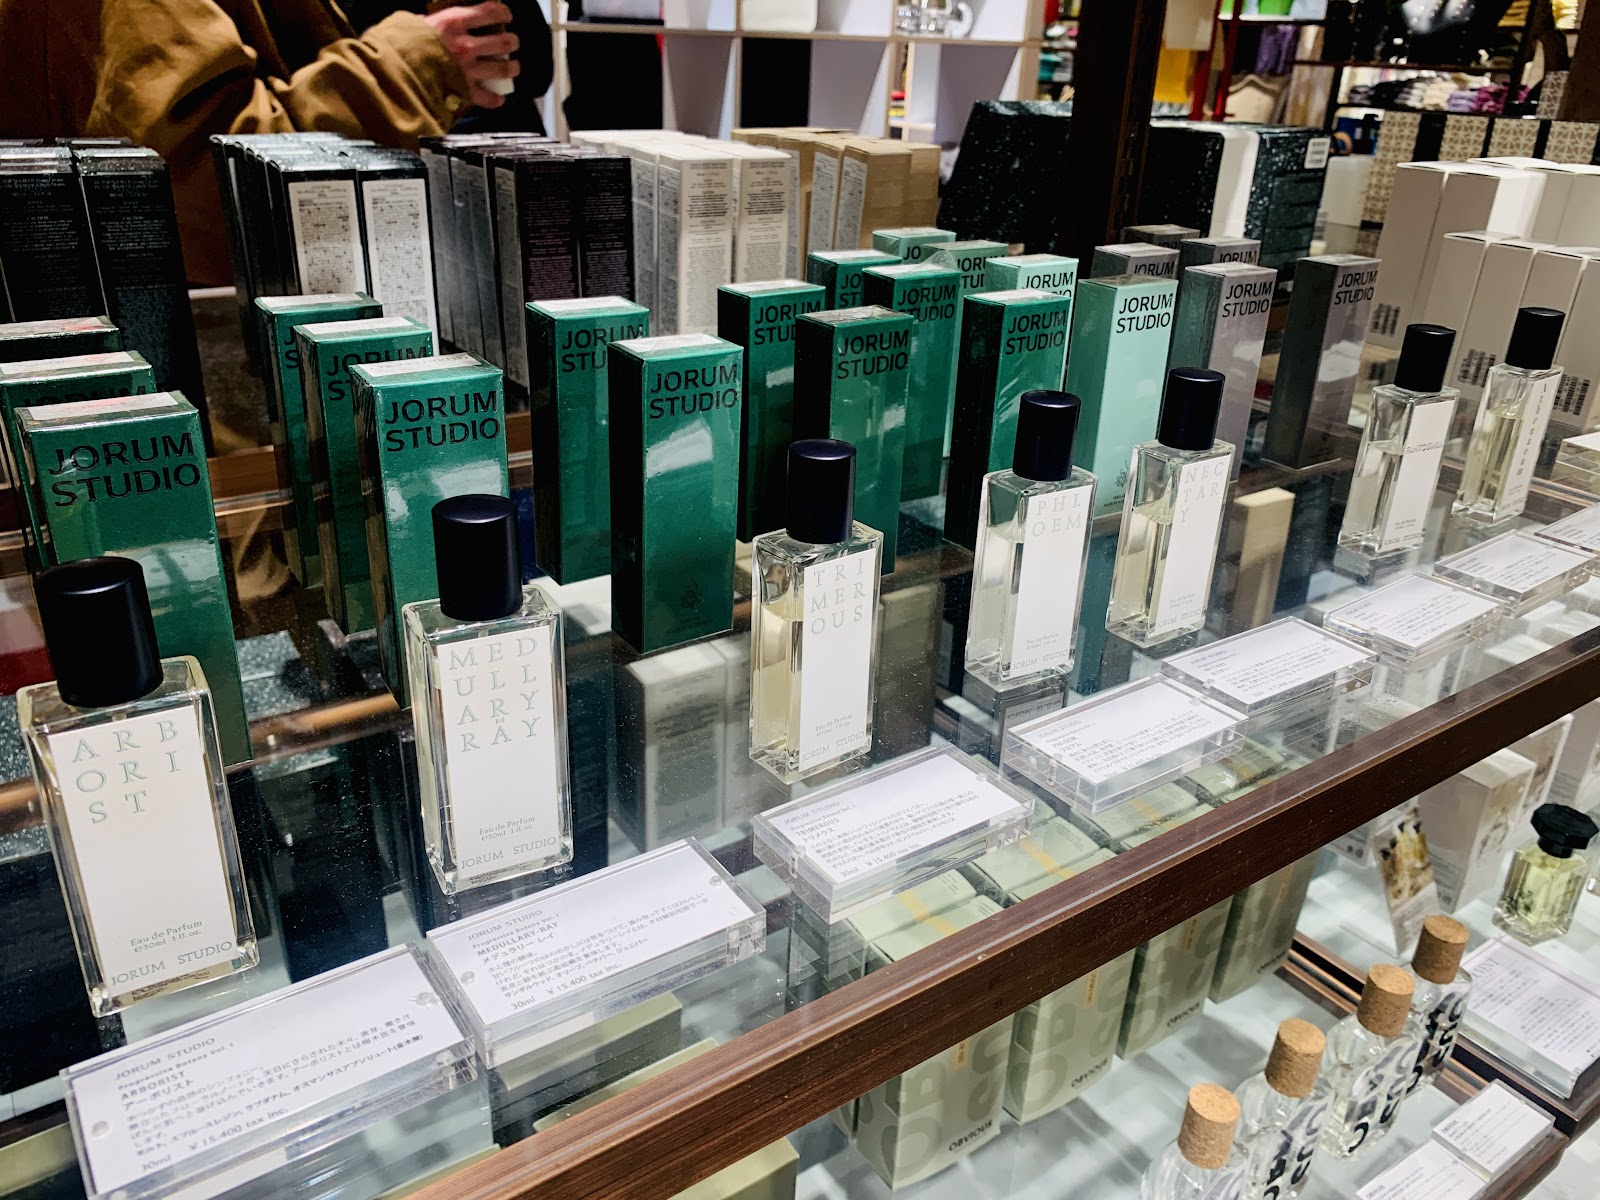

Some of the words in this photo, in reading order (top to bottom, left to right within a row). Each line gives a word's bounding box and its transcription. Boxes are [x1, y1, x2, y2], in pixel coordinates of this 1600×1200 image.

[1022, 271, 1074, 289] JORUM
[1225, 281, 1274, 300] JORUM
[1338, 270, 1378, 289] JORUM
[897, 285, 956, 306] JORUM
[1119, 293, 1173, 314] JORUM
[1222, 299, 1270, 318] STUDIO
[1334, 287, 1374, 305] STUDIO
[755, 301, 821, 325] JORUM
[1008, 310, 1067, 334] JORUM
[1116, 312, 1170, 333] STUDIO
[562, 324, 644, 350] JORUM
[839, 329, 909, 357] JORUM
[1005, 330, 1065, 355] STUDIO
[561, 351, 606, 372] STU
[837, 352, 908, 380] STUDIO
[651, 364, 737, 394] JORUM
[385, 391, 498, 425] JORUM
[650, 388, 738, 419] STUDIO
[386, 418, 500, 452] STUDIO
[49, 433, 194, 476] JORUM
[52, 463, 200, 507] STUDIO
[1012, 657, 1038, 671] JORUM
[1042, 649, 1068, 664] STUDIO
[802, 745, 830, 762] JORUM
[835, 731, 865, 748] STUDIO
[479, 827, 494, 836] Eau
[495, 822, 506, 832] de
[507, 815, 536, 829] Parfum
[782, 811, 810, 824] JORUM
[811, 800, 841, 814] STUDIO
[795, 817, 840, 836] TRIMEROUS
[461, 850, 504, 869] JORUM
[513, 836, 557, 855] STUDIO
[130, 935, 150, 947] Eau
[151, 930, 165, 941] de
[165, 920, 203, 936] Parfum
[466, 924, 502, 941] JORUM
[504, 909, 543, 926] STUDIO
[471, 930, 514, 949] Progressive
[514, 920, 540, 933] Botany
[476, 921, 559, 956] MEDULLARY-RAY
[111, 961, 166, 986] JORUM
[177, 941, 233, 965] STUDIO
[510, 995, 536, 1011] 30ml
[588, 969, 604, 979] tax
[604, 961, 621, 972] inc.
[114, 1057, 161, 1080] JORUM
[166, 1036, 215, 1060] STUDIO
[120, 1070, 184, 1100] ARBORIST
[123, 1077, 194, 1110] アーボリスト
[949, 1119, 993, 1151] OBVIOUS
